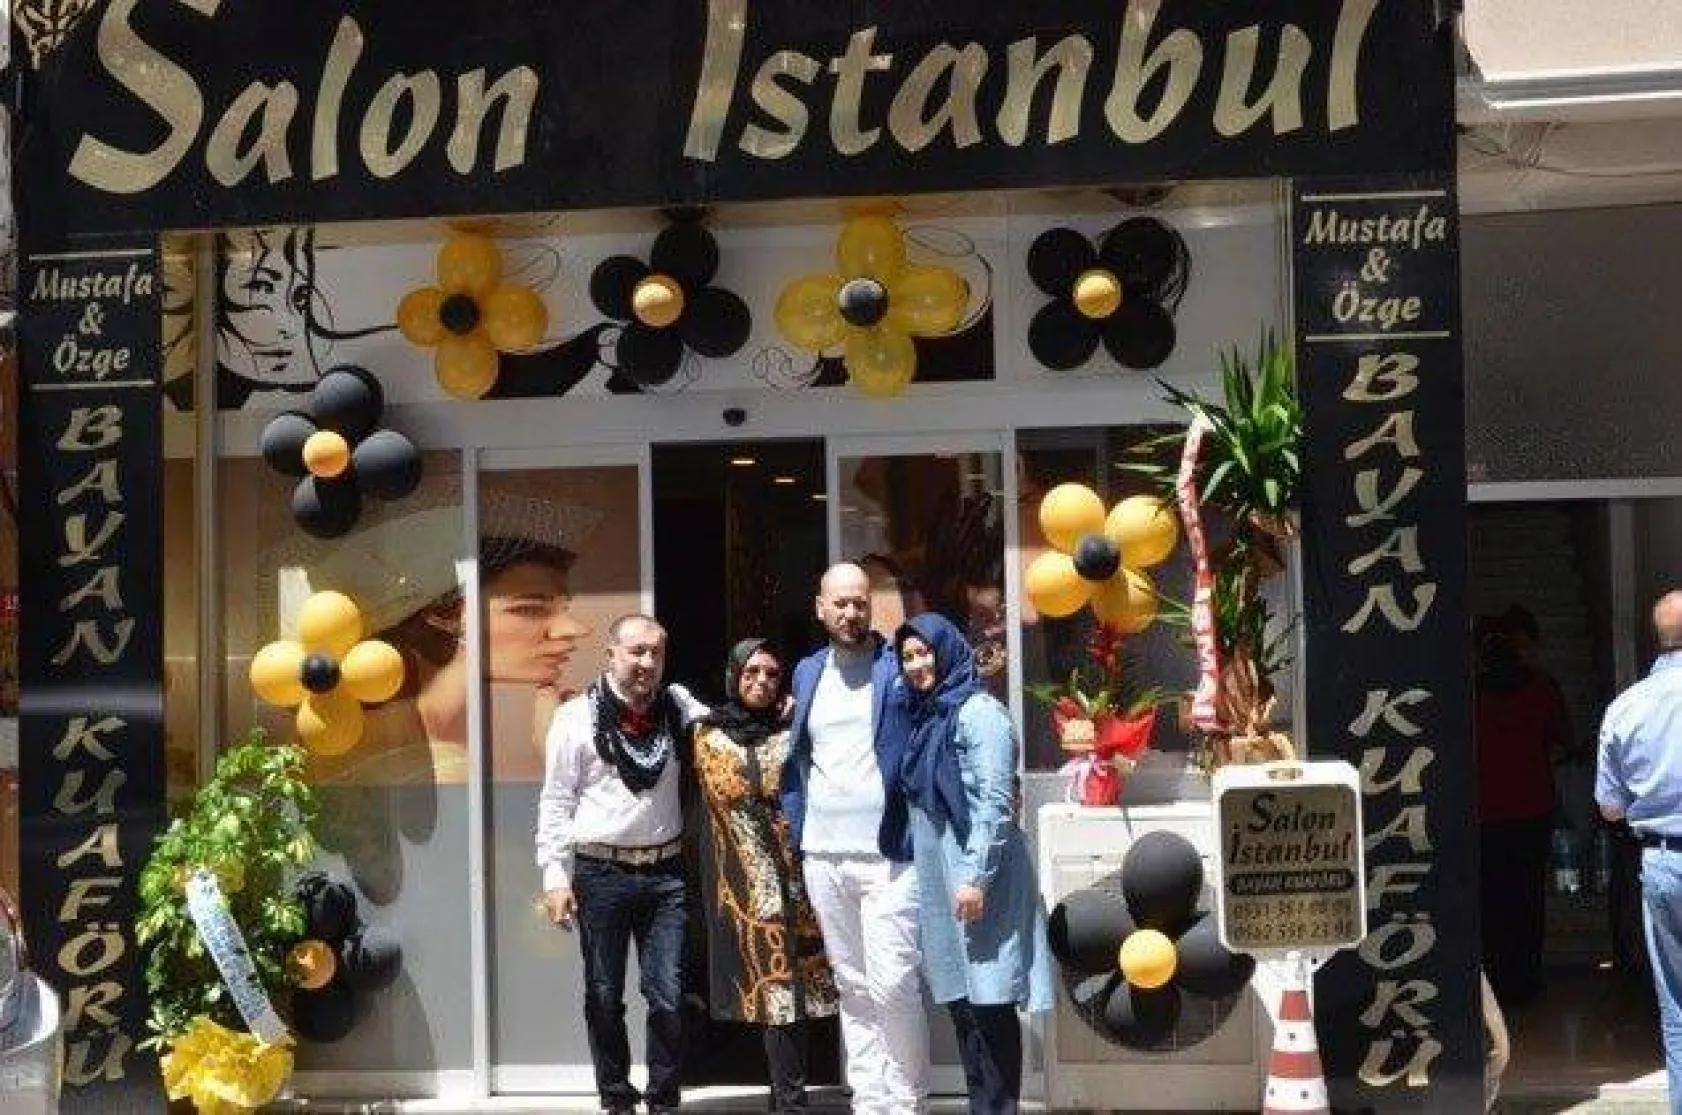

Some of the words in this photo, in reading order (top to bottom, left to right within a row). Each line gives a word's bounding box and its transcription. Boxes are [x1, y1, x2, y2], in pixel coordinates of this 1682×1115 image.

[67, 0, 540, 194] Salon
[1305, 205, 1447, 249] Mustafa
[31, 262, 153, 305] Mustafa
[1361, 248, 1390, 282] &
[78, 301, 103, 335] &
[1332, 281, 1421, 330] Özge
[53, 334, 131, 381] Özge
[1341, 354, 1437, 634] BAYAN
[50, 405, 136, 666] BAYAN
[1247, 794, 1336, 834] Salon
